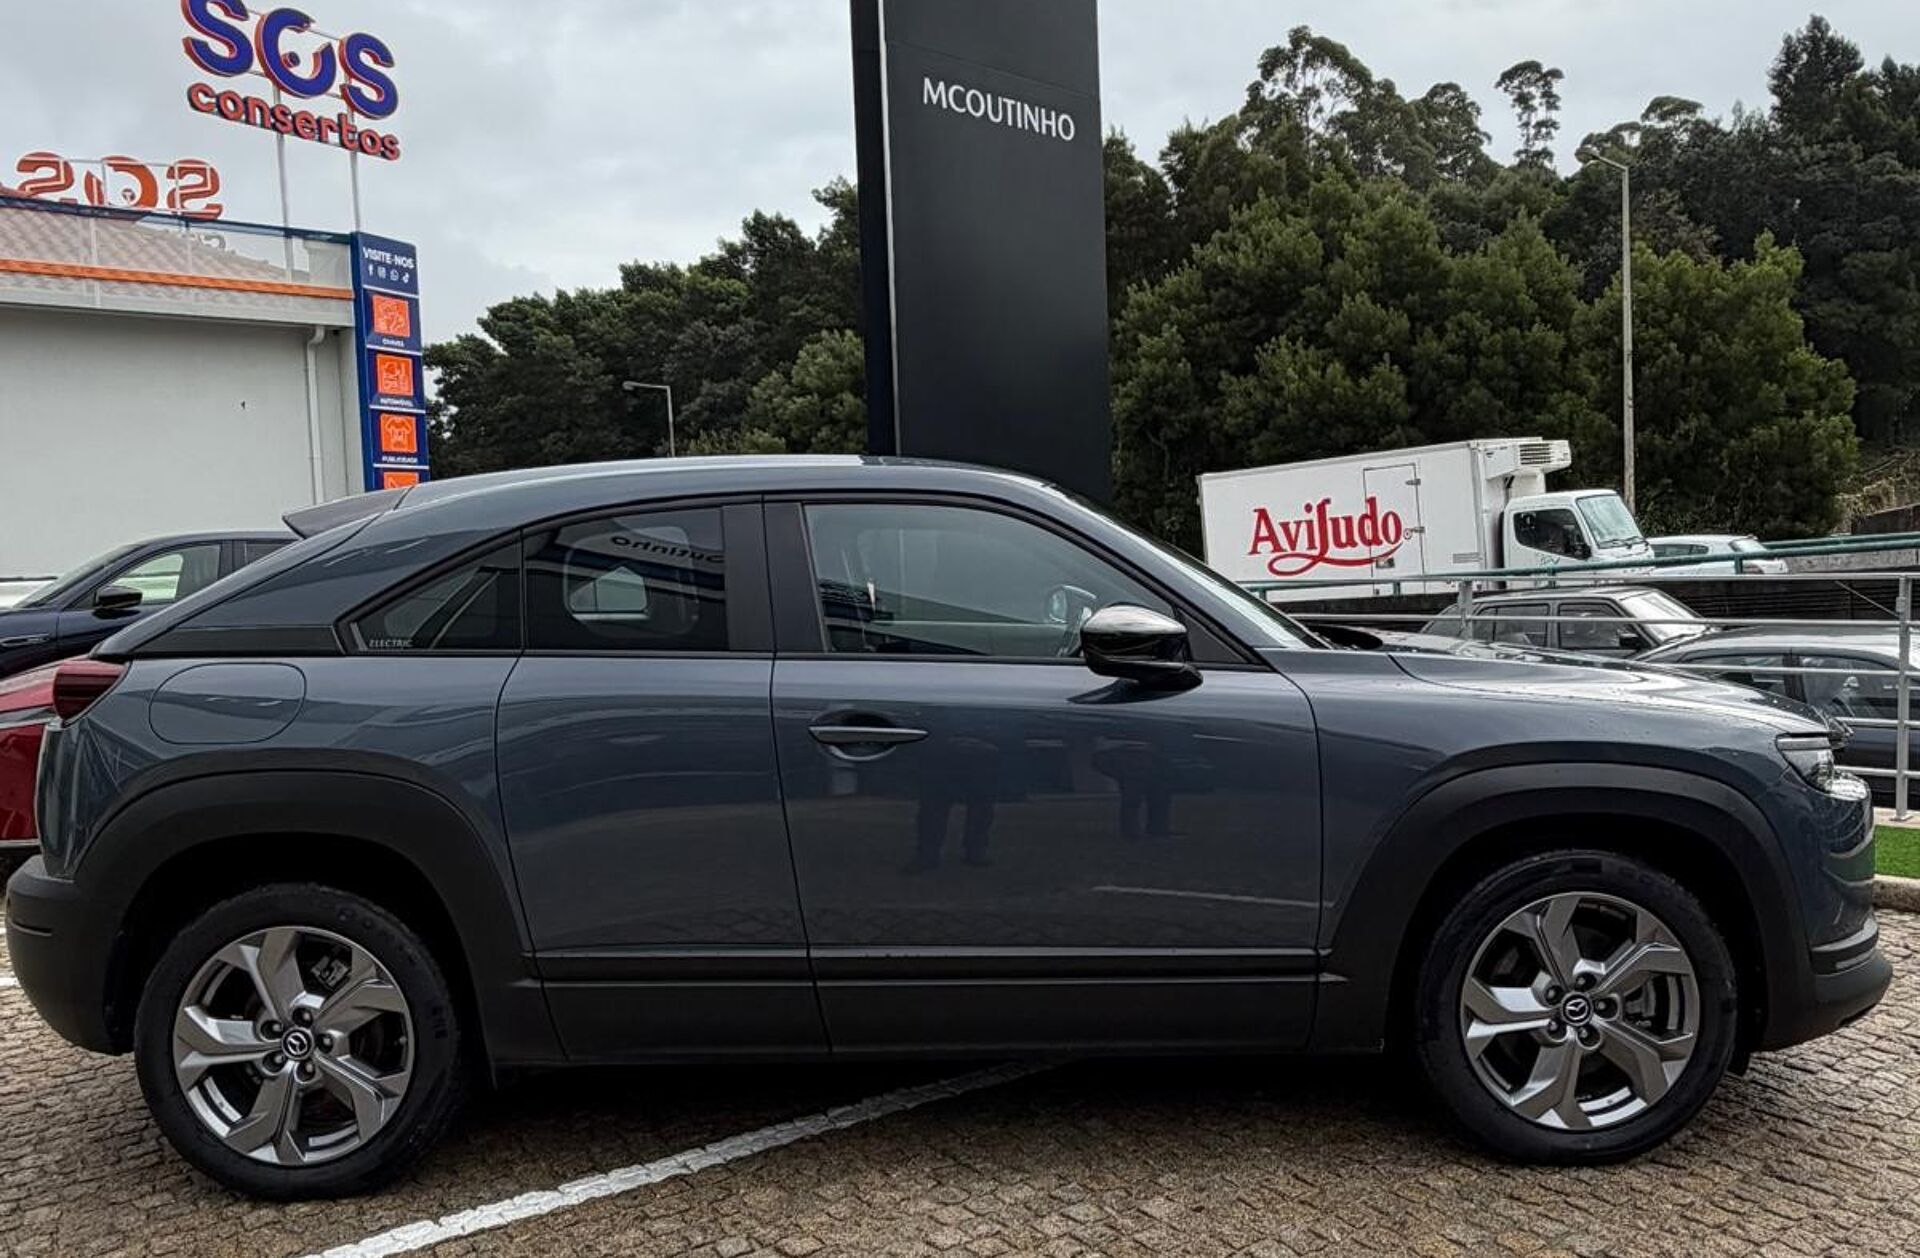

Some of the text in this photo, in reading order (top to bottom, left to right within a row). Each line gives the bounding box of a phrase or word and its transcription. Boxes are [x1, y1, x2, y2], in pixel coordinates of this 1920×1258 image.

[187, 82, 401, 161] consertos
[922, 77, 1076, 142] MCOUTINHO
[362, 246, 415, 269] VISITE-NOS
[368, 639, 414, 648] ELECTRIC
